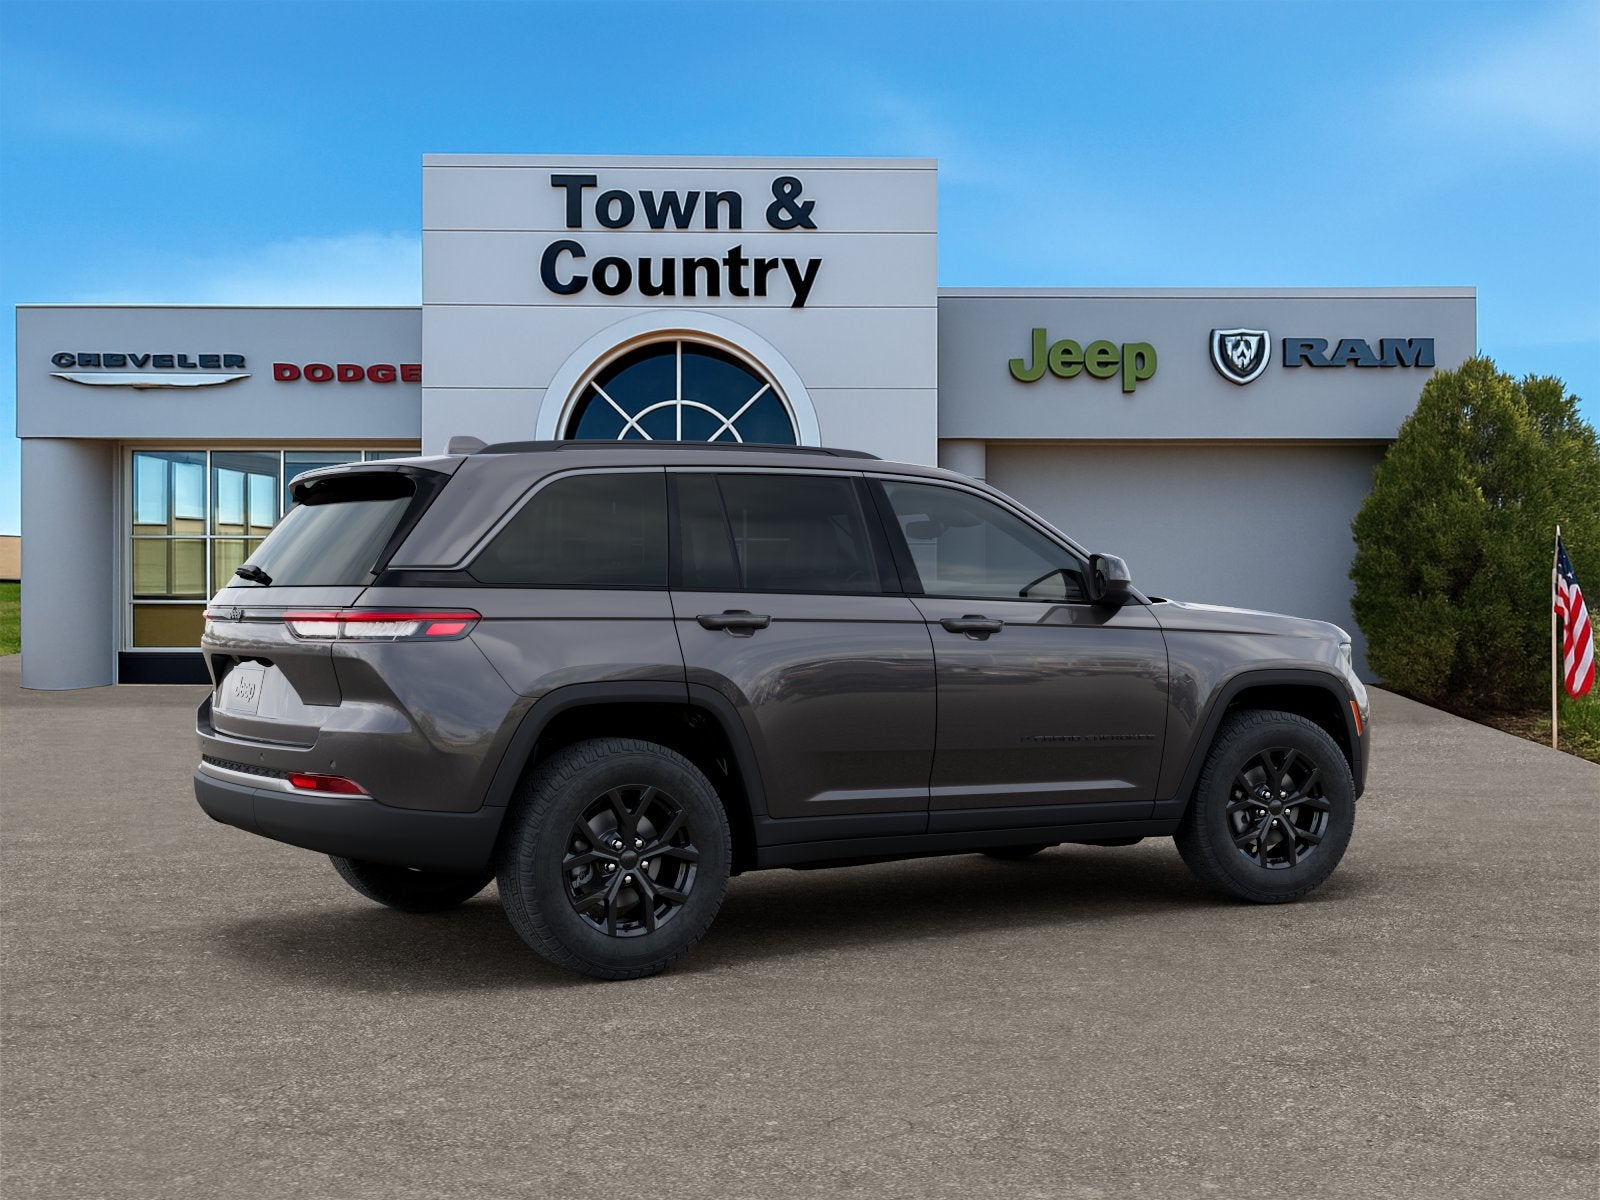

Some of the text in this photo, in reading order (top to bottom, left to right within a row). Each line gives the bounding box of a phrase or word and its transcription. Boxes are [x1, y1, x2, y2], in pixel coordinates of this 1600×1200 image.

[550, 174, 818, 230] Town &
[539, 239, 822, 309] Country
[272, 362, 422, 383] DODGE
[1009, 327, 1158, 392] Jeep
[1282, 337, 1436, 368] RAM
